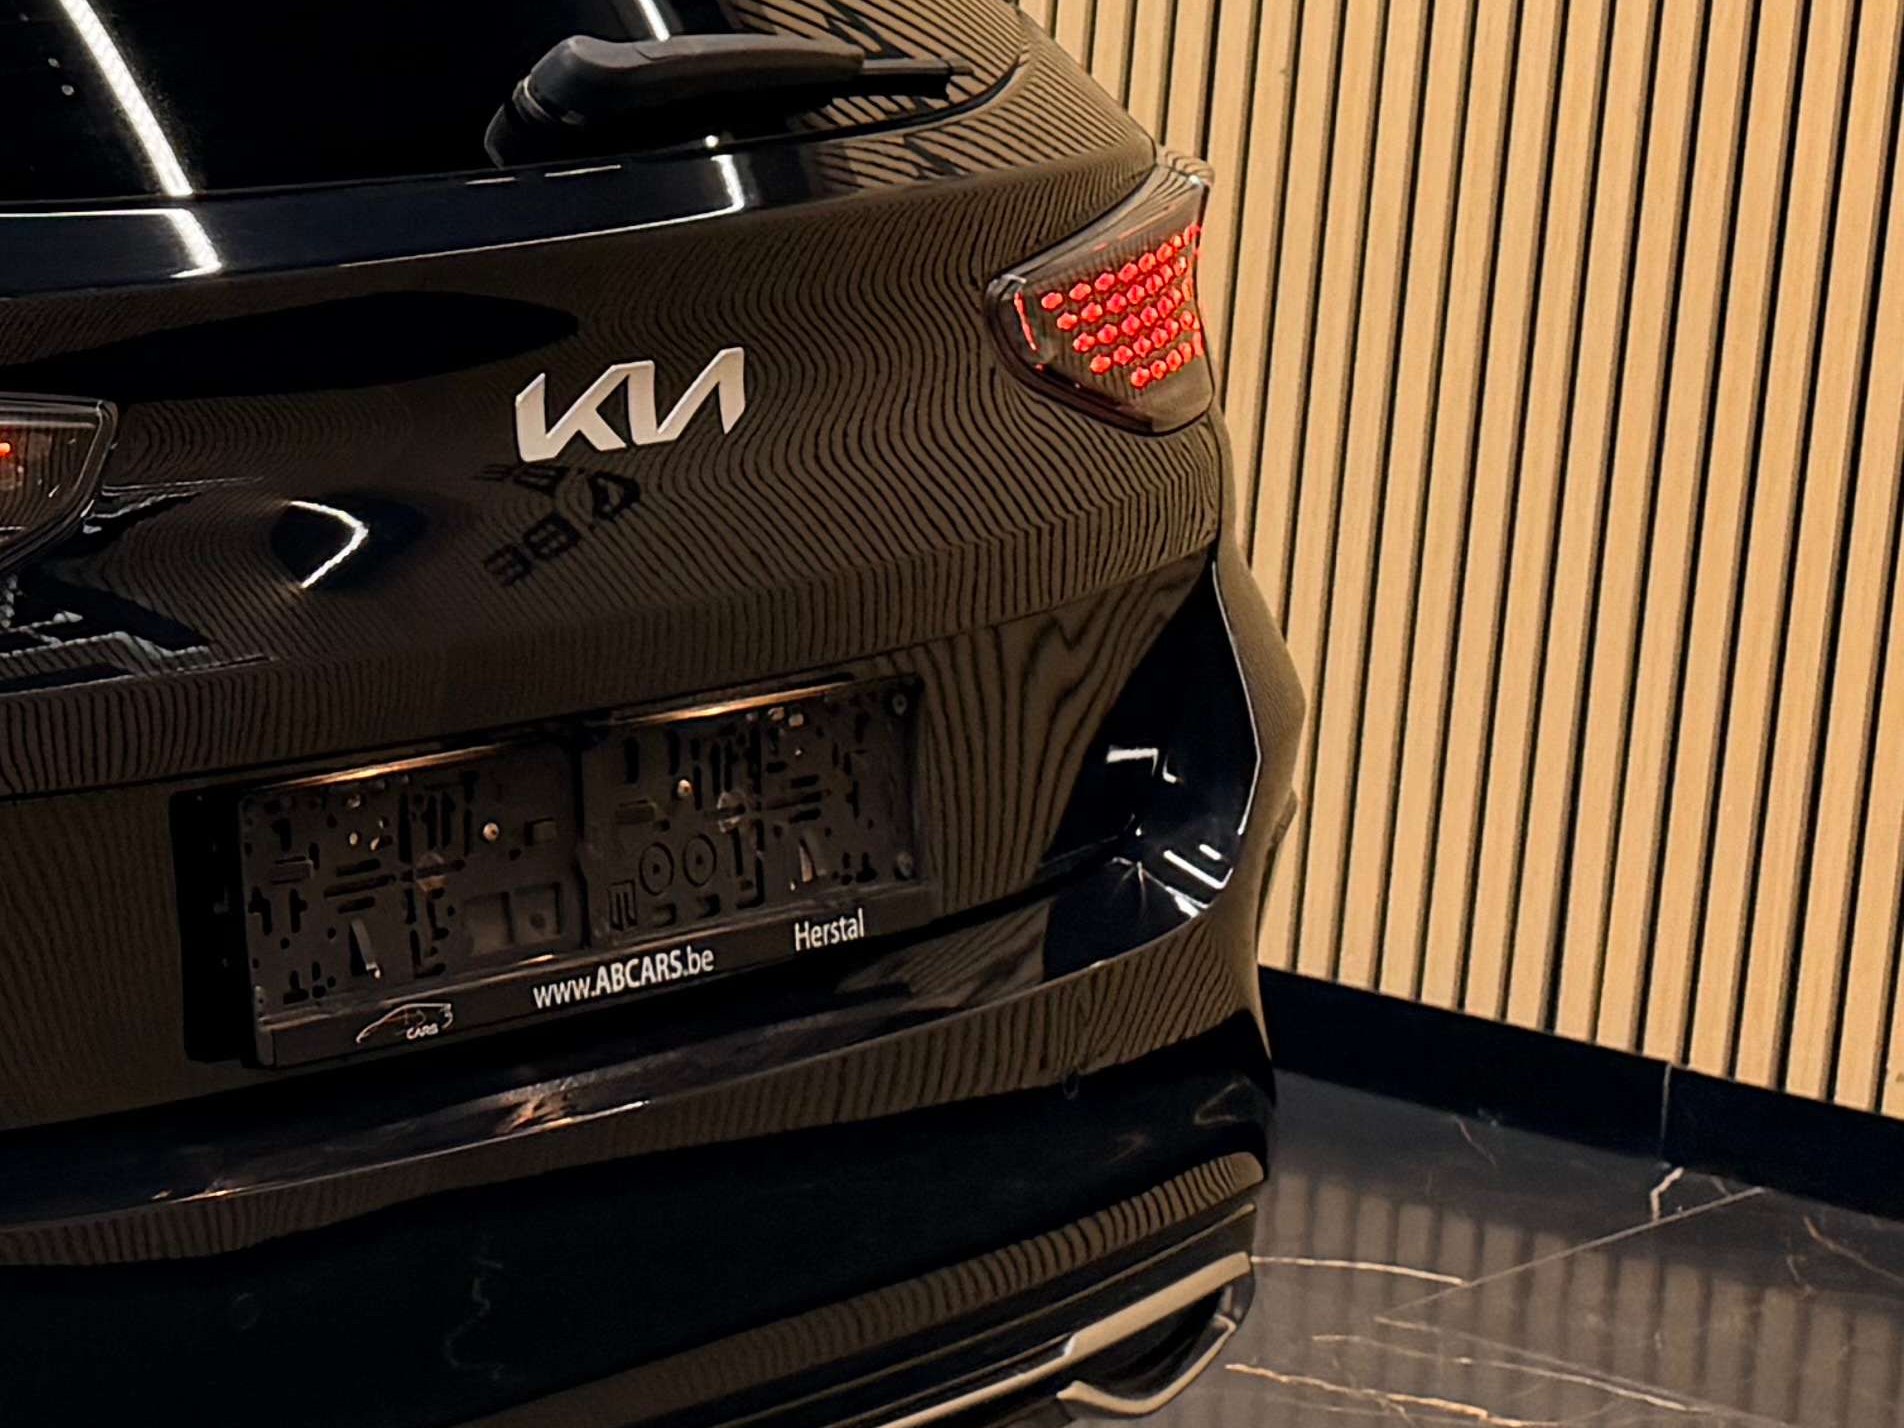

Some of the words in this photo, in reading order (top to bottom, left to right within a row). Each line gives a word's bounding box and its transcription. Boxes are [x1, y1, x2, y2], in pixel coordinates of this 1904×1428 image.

[515, 346, 746, 463] KIA
[533, 945, 715, 1009] www.ABCARS.be
[794, 908, 865, 952] Herstal
